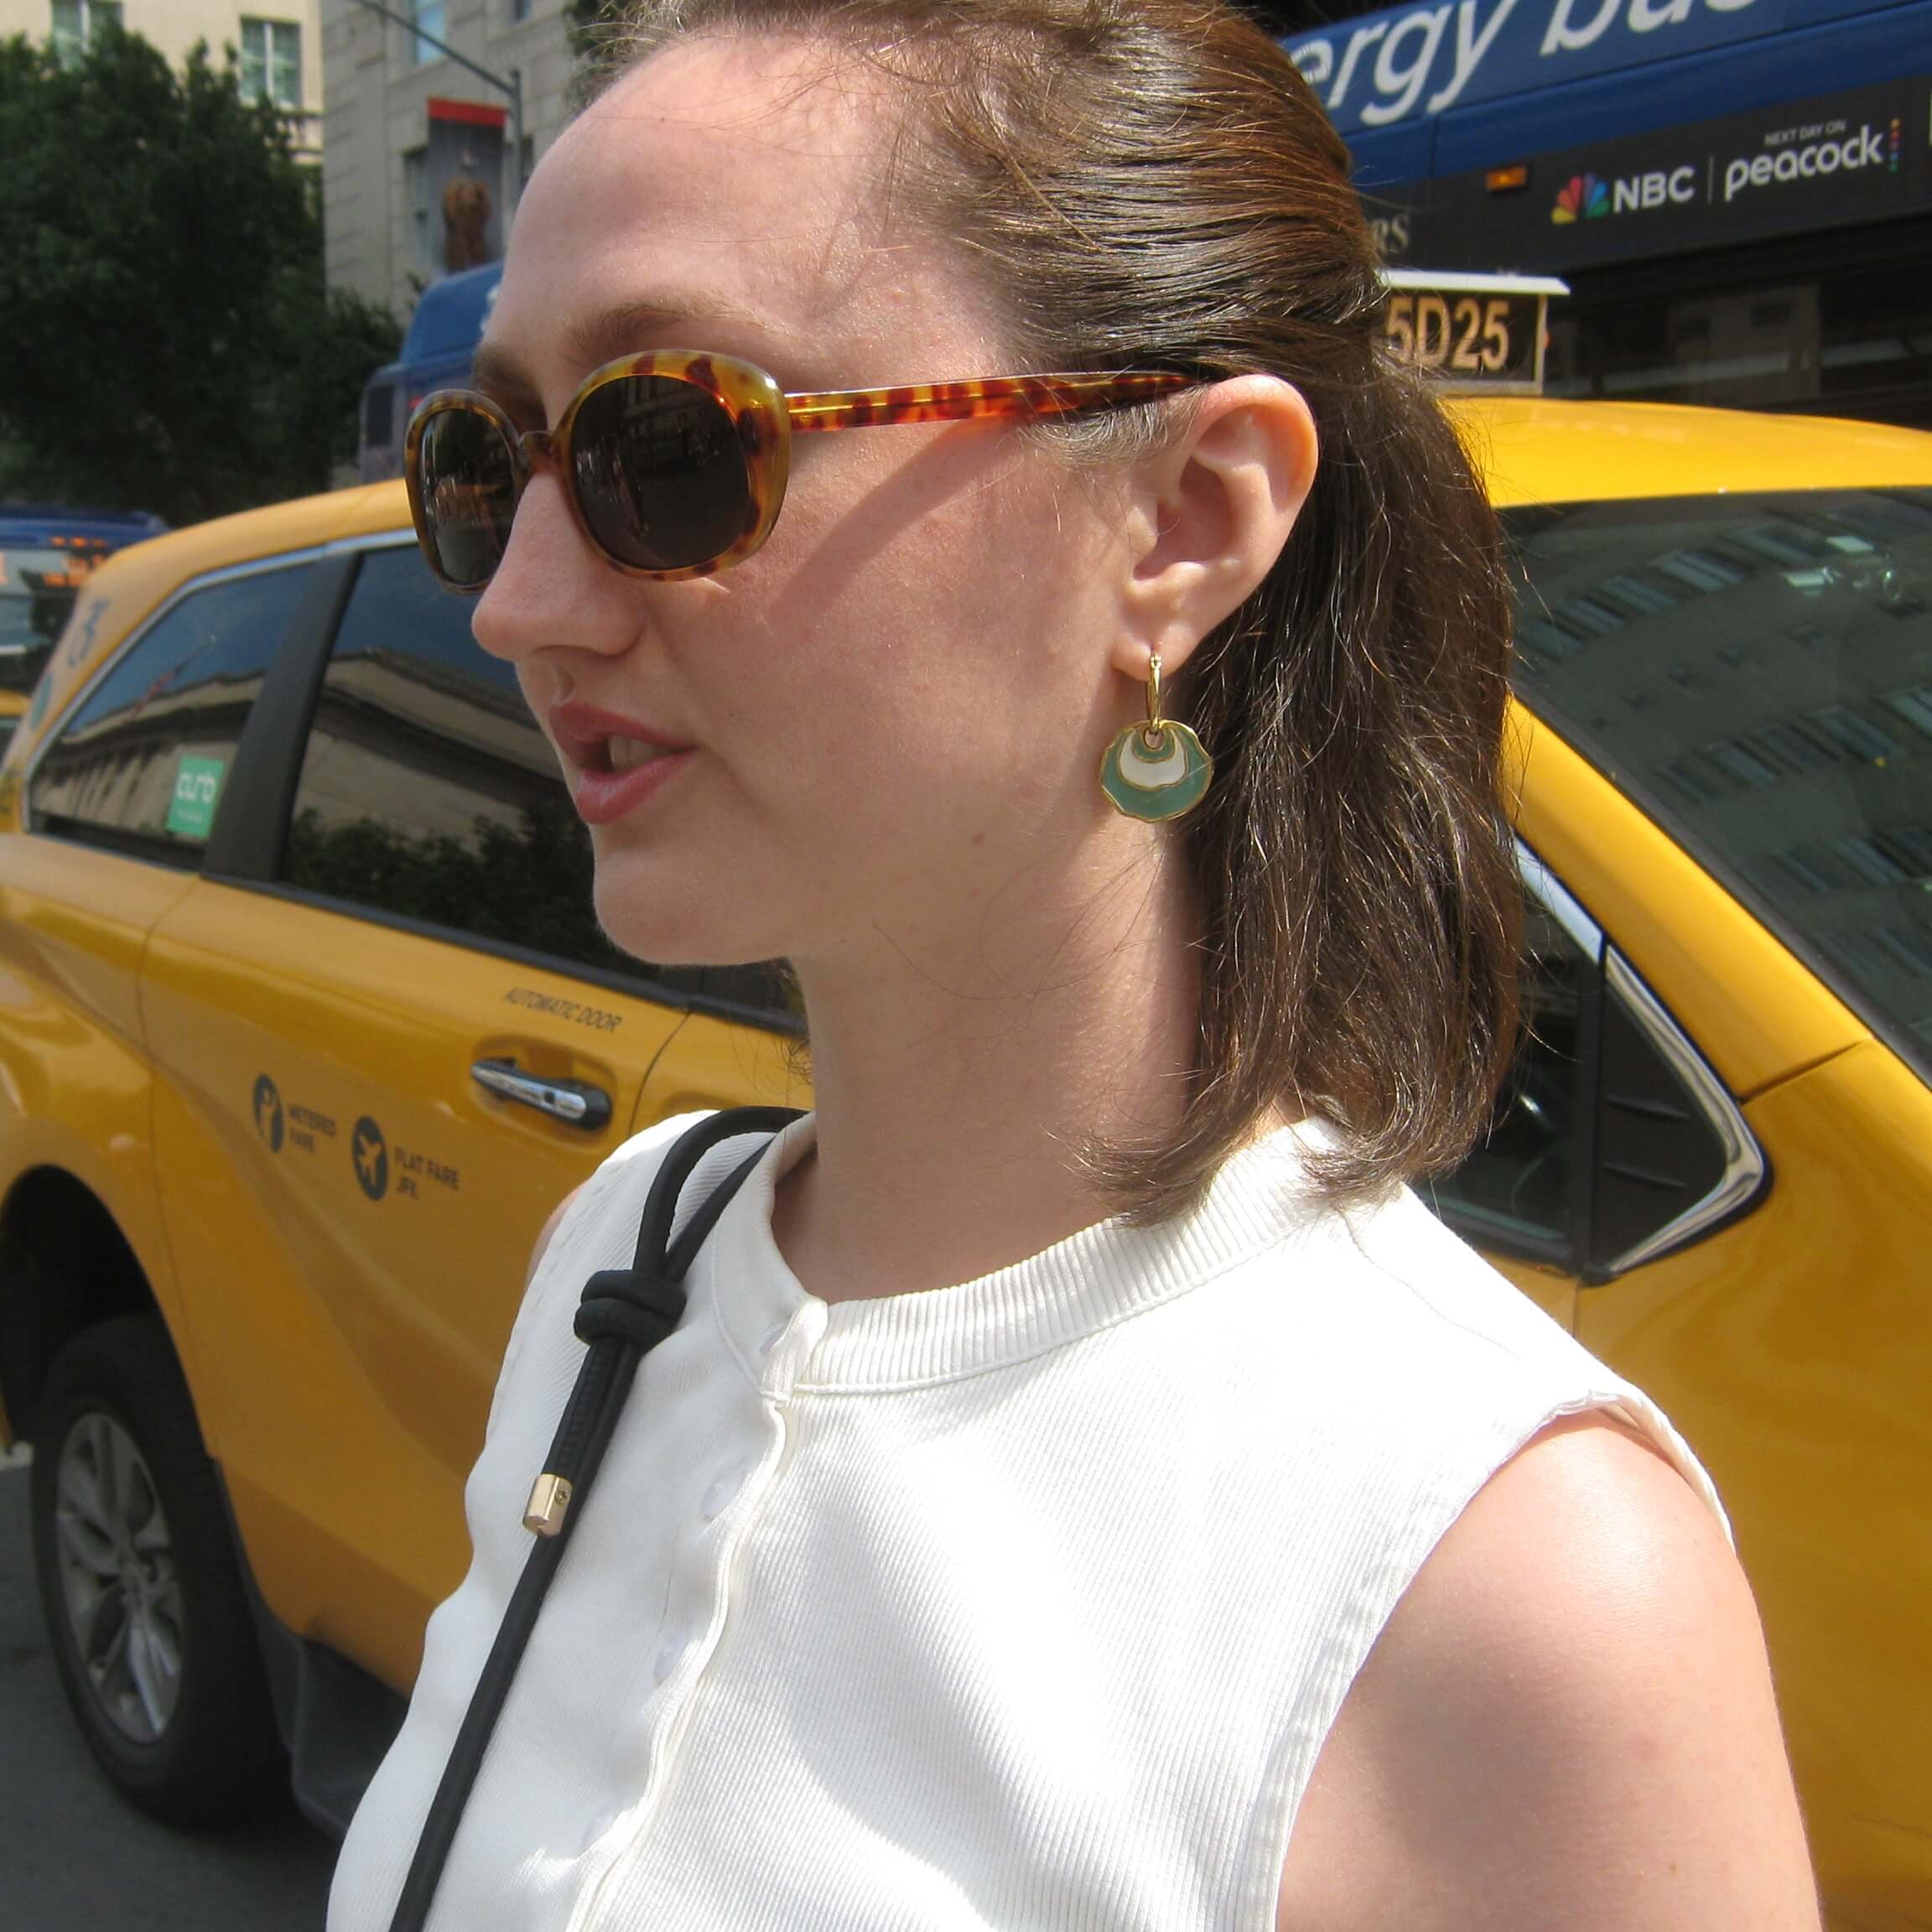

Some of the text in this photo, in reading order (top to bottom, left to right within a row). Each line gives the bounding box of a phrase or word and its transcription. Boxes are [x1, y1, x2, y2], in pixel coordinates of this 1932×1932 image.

[1764, 119, 1846, 147] NEXT DAY ON
[1724, 125, 1885, 202] peacock
[1613, 166, 1696, 214] NBC
[1386, 296, 1509, 371] 5D25
[505, 987, 623, 1034] AUTOMATIC DOOR
[289, 1104, 336, 1138] METERED
[395, 1146, 460, 1192] FLAT FARE
